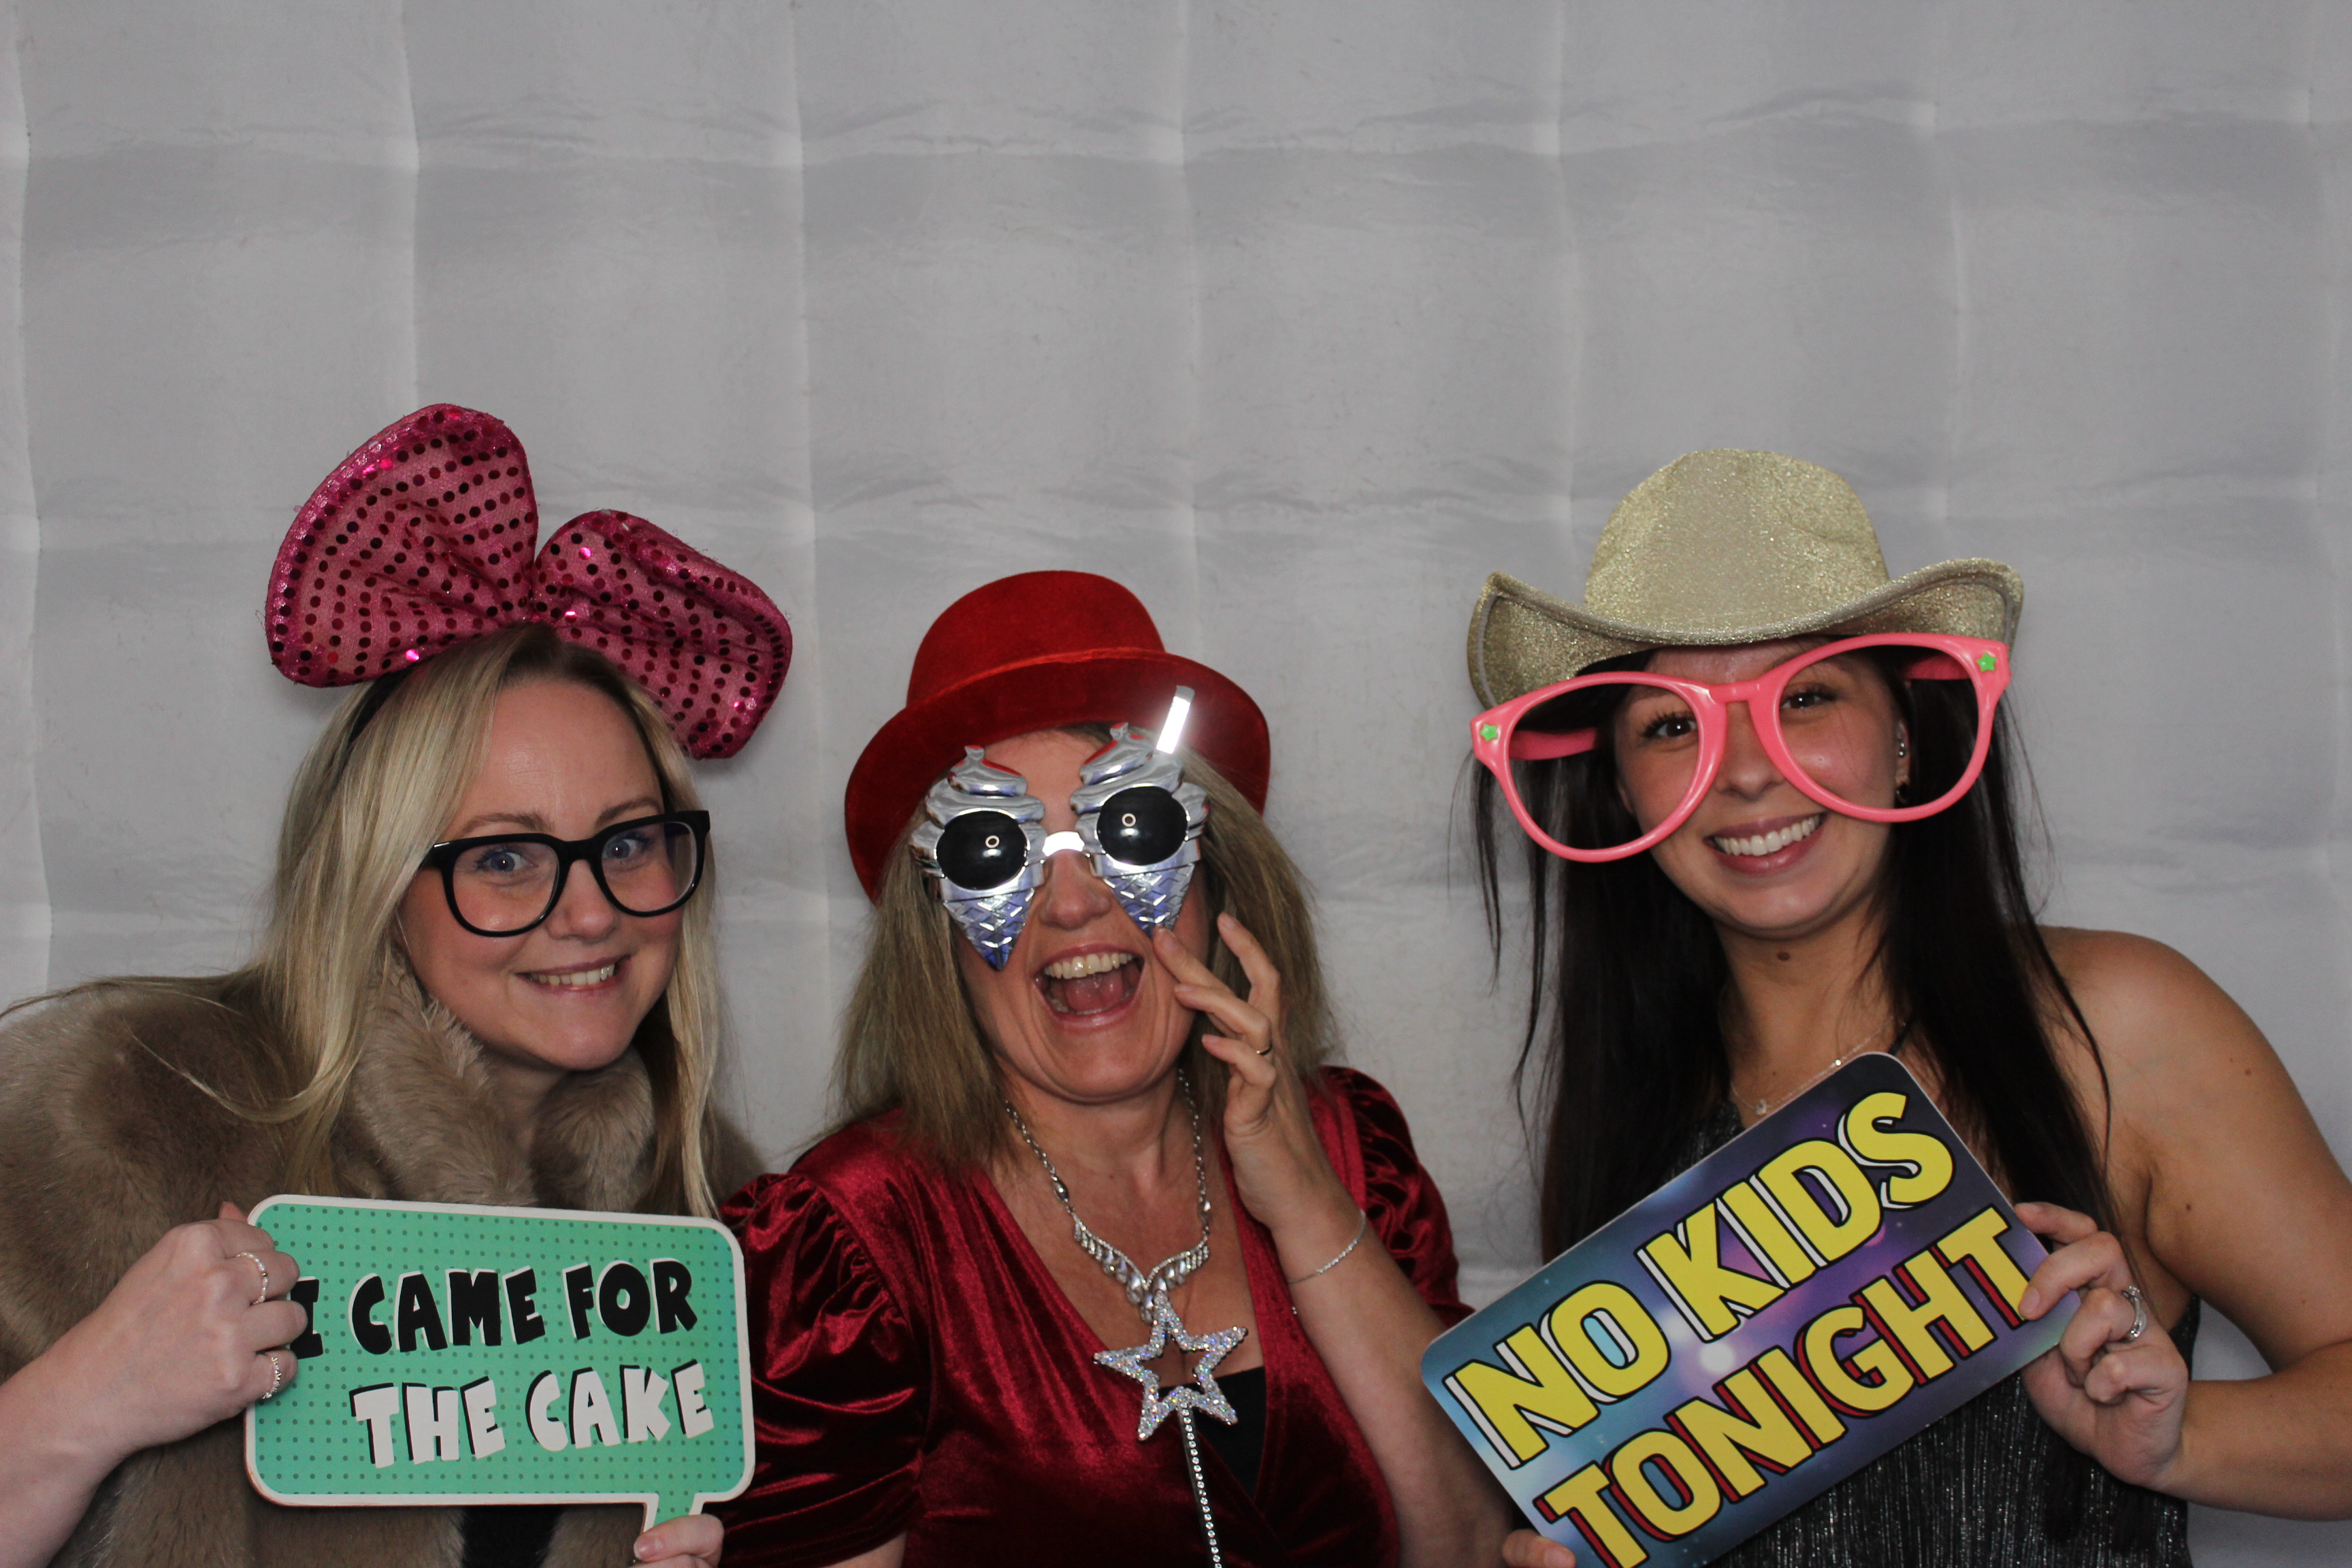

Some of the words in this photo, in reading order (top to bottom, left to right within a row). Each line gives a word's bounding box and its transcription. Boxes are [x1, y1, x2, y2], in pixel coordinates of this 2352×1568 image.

[287, 1276, 324, 1360] I
[348, 1265, 544, 1356] CAME
[562, 1257, 699, 1340] FOR
[1441, 1279, 1671, 1471] NO
[1635, 1090, 1955, 1343] KIDS
[1533, 1205, 2035, 1568] TONIGHT
[348, 1375, 506, 1469] THE
[525, 1360, 715, 1452] CAKE
